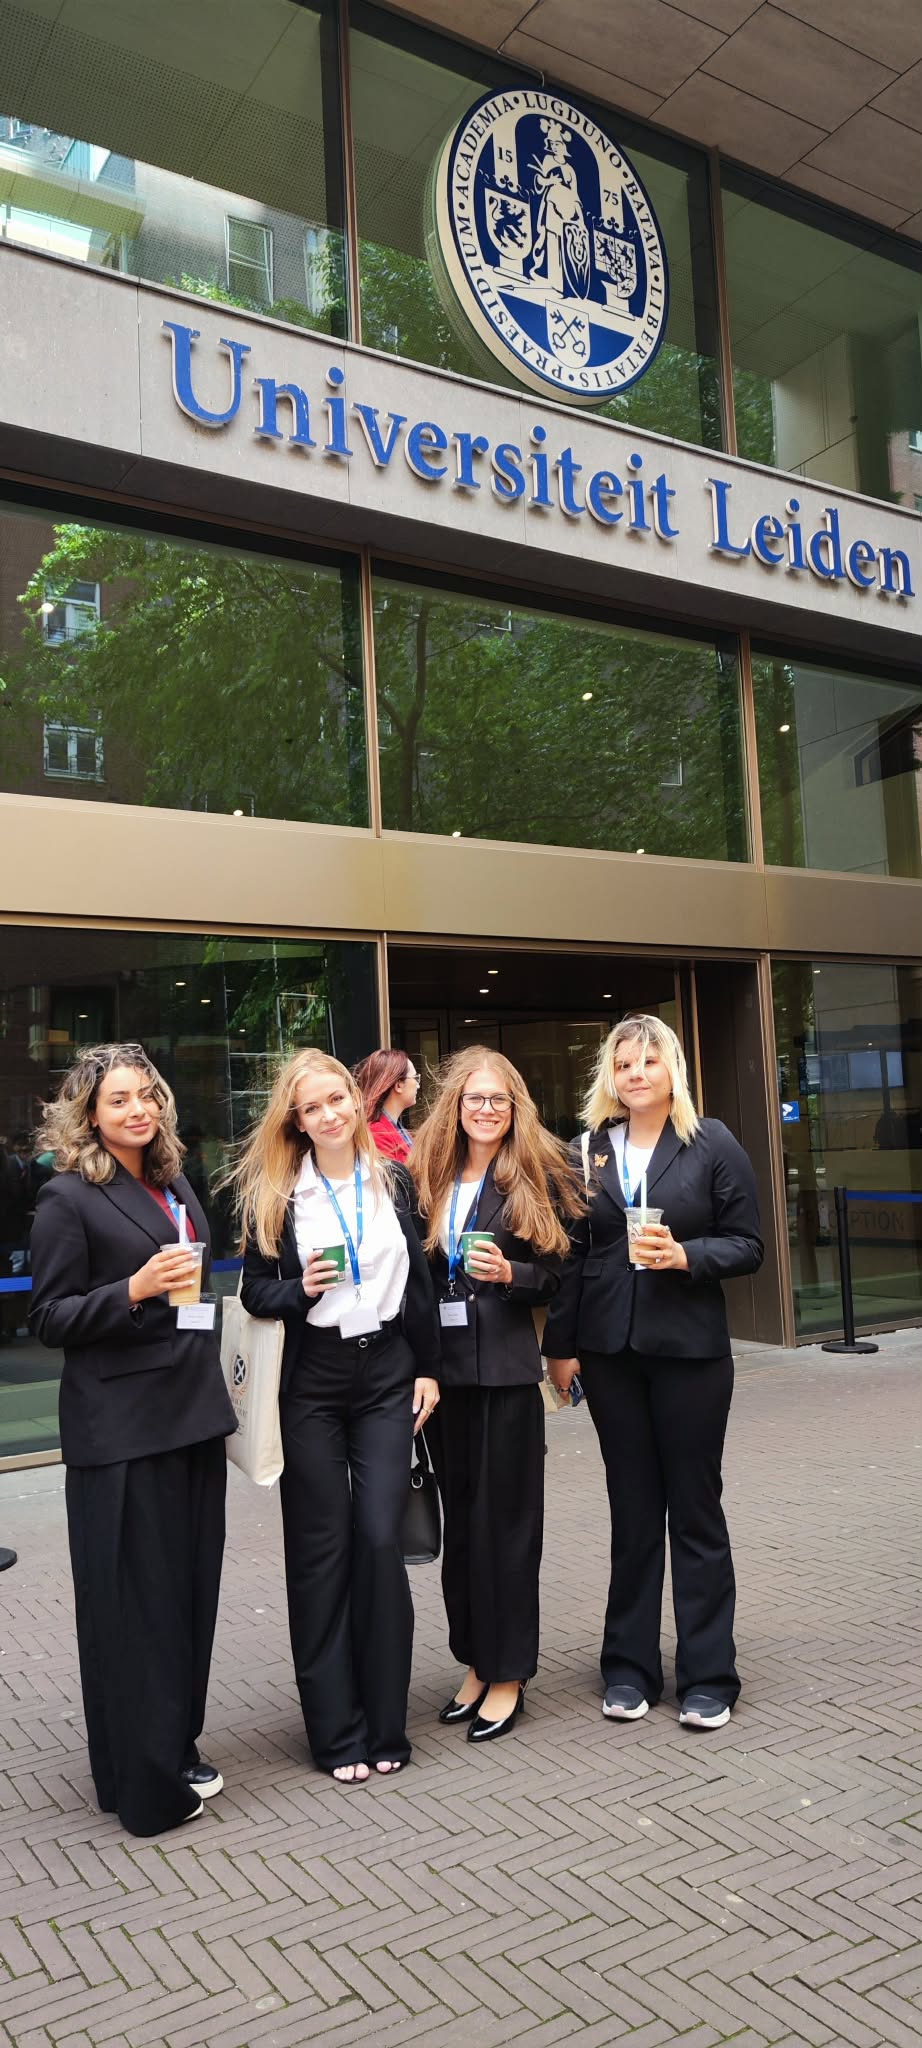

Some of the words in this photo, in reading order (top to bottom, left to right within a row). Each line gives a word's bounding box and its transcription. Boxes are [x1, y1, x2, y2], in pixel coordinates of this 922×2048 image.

[456, 95, 513, 199] ACADEMIA
[497, 146, 513, 163] 15
[525, 92, 623, 169] LUGDUNO
[603, 190, 619, 205] 75
[628, 181, 660, 270] BATAVA
[457, 217, 563, 380] PRAESIDIUM
[580, 288, 663, 388] LIBERTATIS
[161, 320, 680, 540] Universiteit
[705, 478, 916, 598] Leiden
